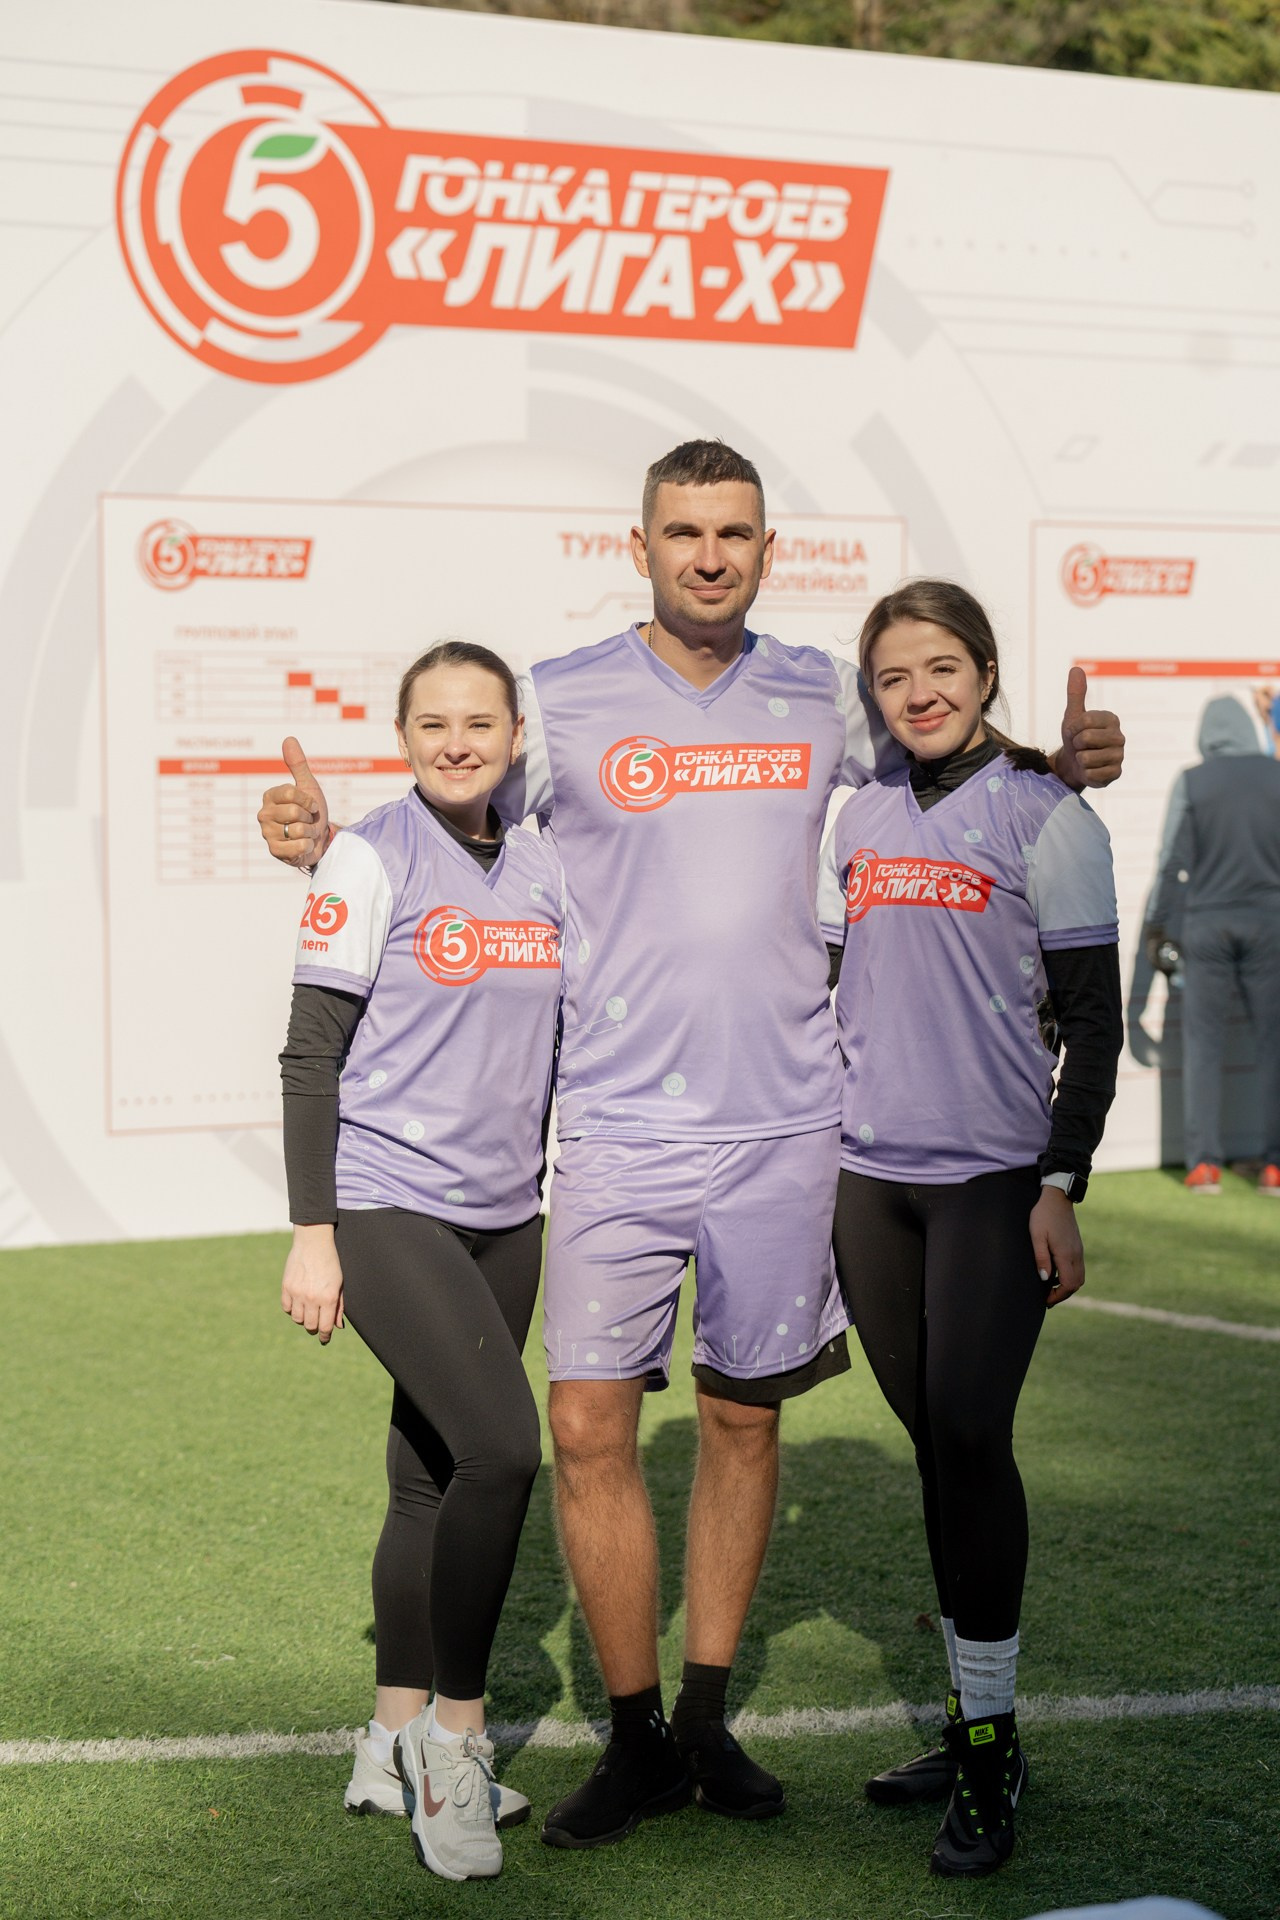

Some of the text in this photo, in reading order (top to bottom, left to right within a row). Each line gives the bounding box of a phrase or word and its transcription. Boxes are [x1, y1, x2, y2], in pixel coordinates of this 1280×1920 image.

[219, 121, 329, 290] 5
[396, 153, 852, 242] ГОНКА ГЕРОЕВ
[385, 224, 846, 324] «ЛИГА-Х»
[774, 537, 868, 565] БЛИЦА
[628, 752, 655, 790] 5
[674, 749, 802, 766] ГОНКА ГЕРОЕВ
[673, 763, 803, 787] «ЛИГА-Х»
[875, 863, 982, 886] ГОНКА ГЕРОЕВ
[872, 878, 982, 904] «ЛИГА-Х»
[300, 892, 348, 936] 25
[441, 921, 467, 963] 5
[483, 925, 528, 941] ГОНКА
[483, 941, 560, 963] «ЛИГА-Х
[974, 1726, 989, 1737] NIKE
